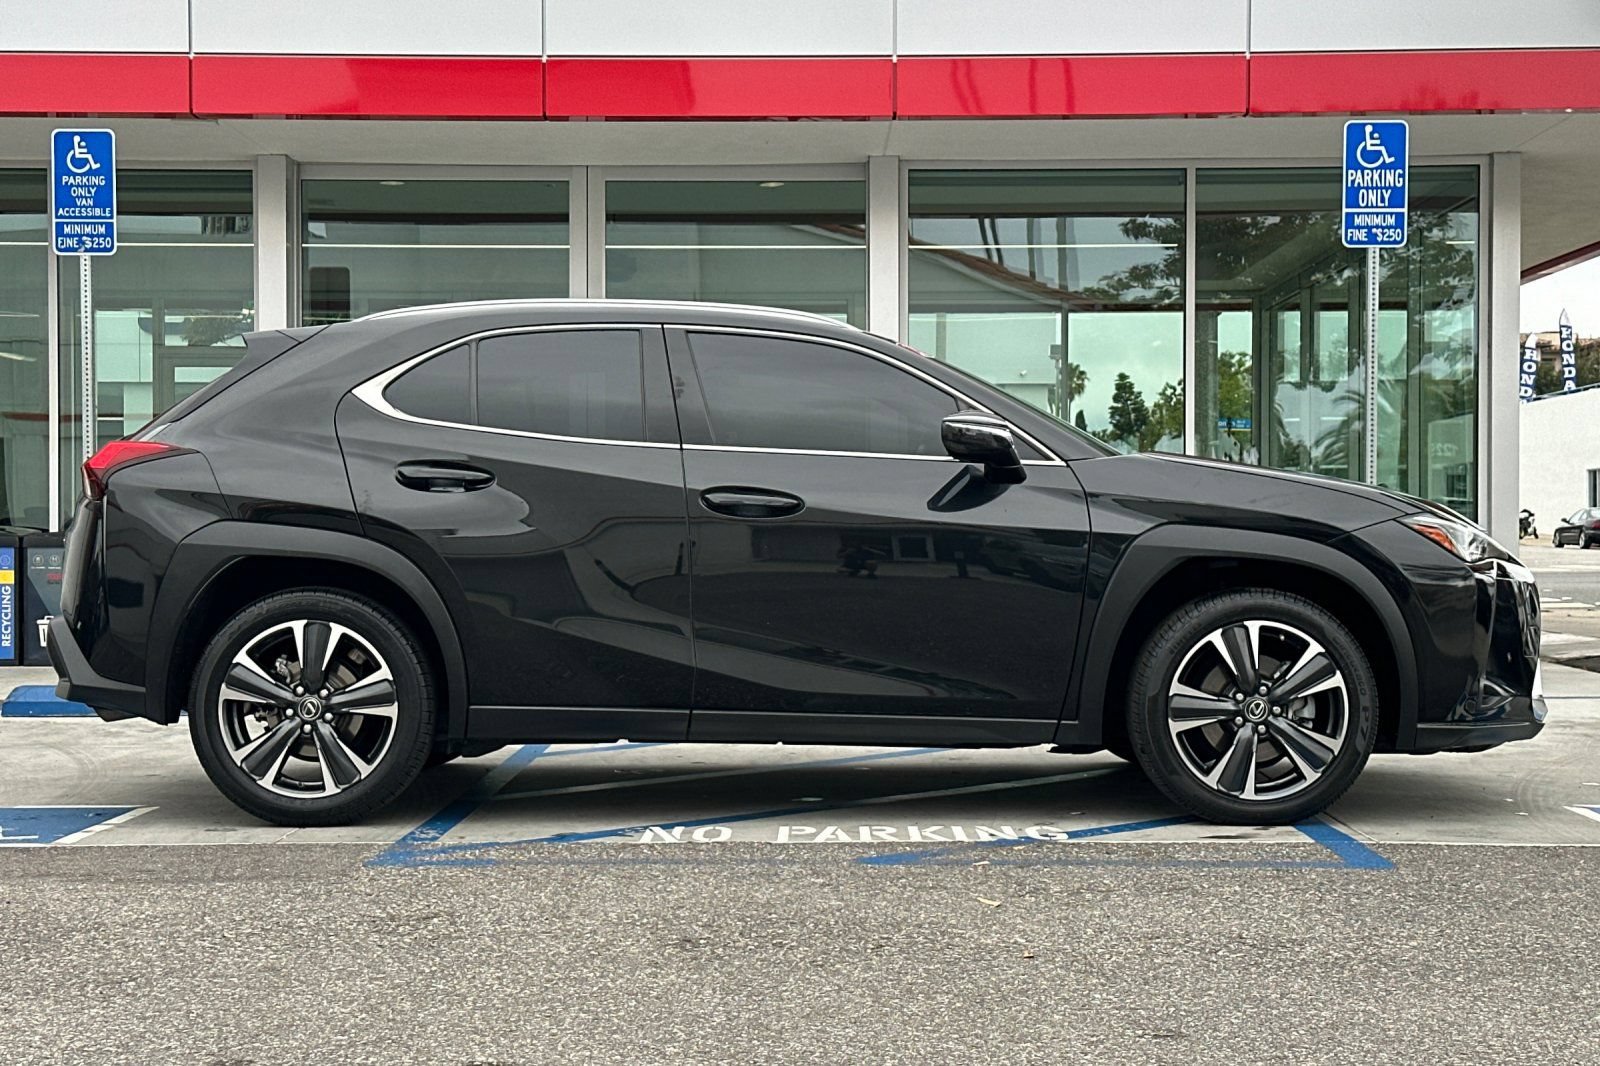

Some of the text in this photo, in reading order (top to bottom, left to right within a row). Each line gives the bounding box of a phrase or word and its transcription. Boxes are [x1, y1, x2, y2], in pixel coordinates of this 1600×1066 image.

[62, 175, 106, 186] PARKING
[1347, 169, 1403, 187] PARKING
[70, 187, 97, 197] ONLY
[1358, 189, 1391, 207] ONLY
[75, 198, 94, 206] VAN
[58, 207, 111, 217] ACCESSIBLE
[1354, 214, 1396, 226] MINIMUM
[63, 224, 106, 234] MINIMUM
[1347, 228, 1402, 242] FINE $250
[57, 236, 112, 249] FINE $250
[1560, 327, 1577, 391] HONDA
[1519, 348, 1537, 397] HOND
[1, 585, 11, 647] RECYCLING
[639, 825, 1069, 843] NO PARKING
